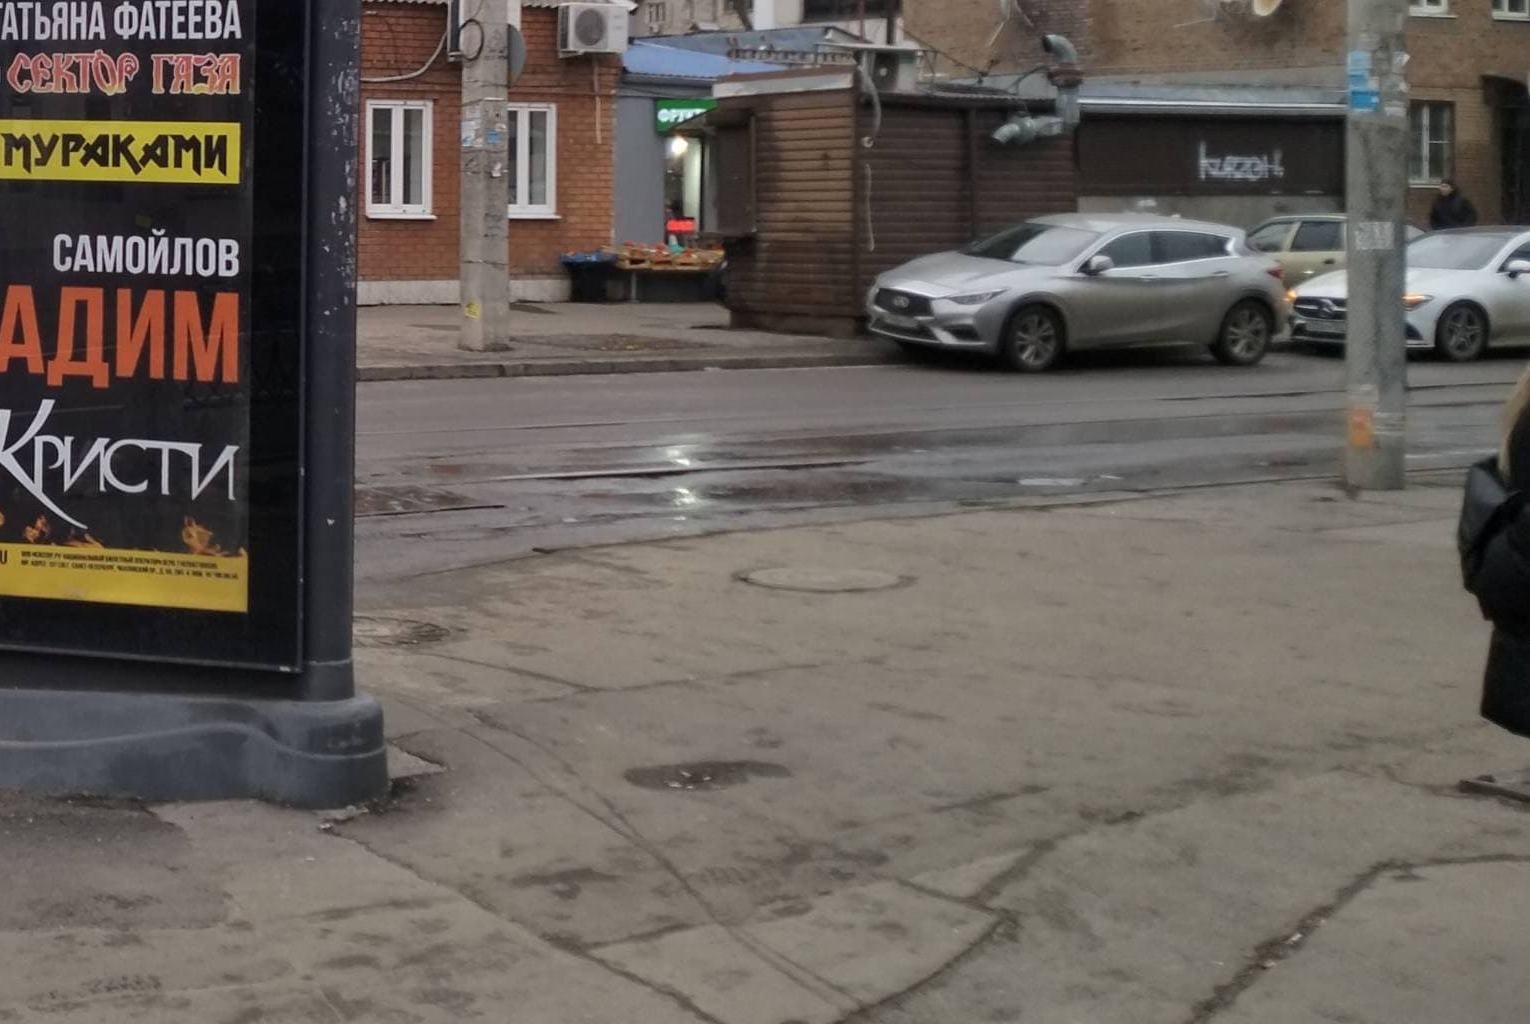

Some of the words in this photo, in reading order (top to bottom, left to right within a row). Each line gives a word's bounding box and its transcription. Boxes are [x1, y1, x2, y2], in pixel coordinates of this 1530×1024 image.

[113, 0, 242, 41] ФАТЕЕВА
[6, 50, 139, 95] СЕКТОР
[150, 53, 242, 95] ГАЗА
[1, 132, 228, 177] МУРАКАМИ
[52, 228, 239, 277] САМОЙЛОВ
